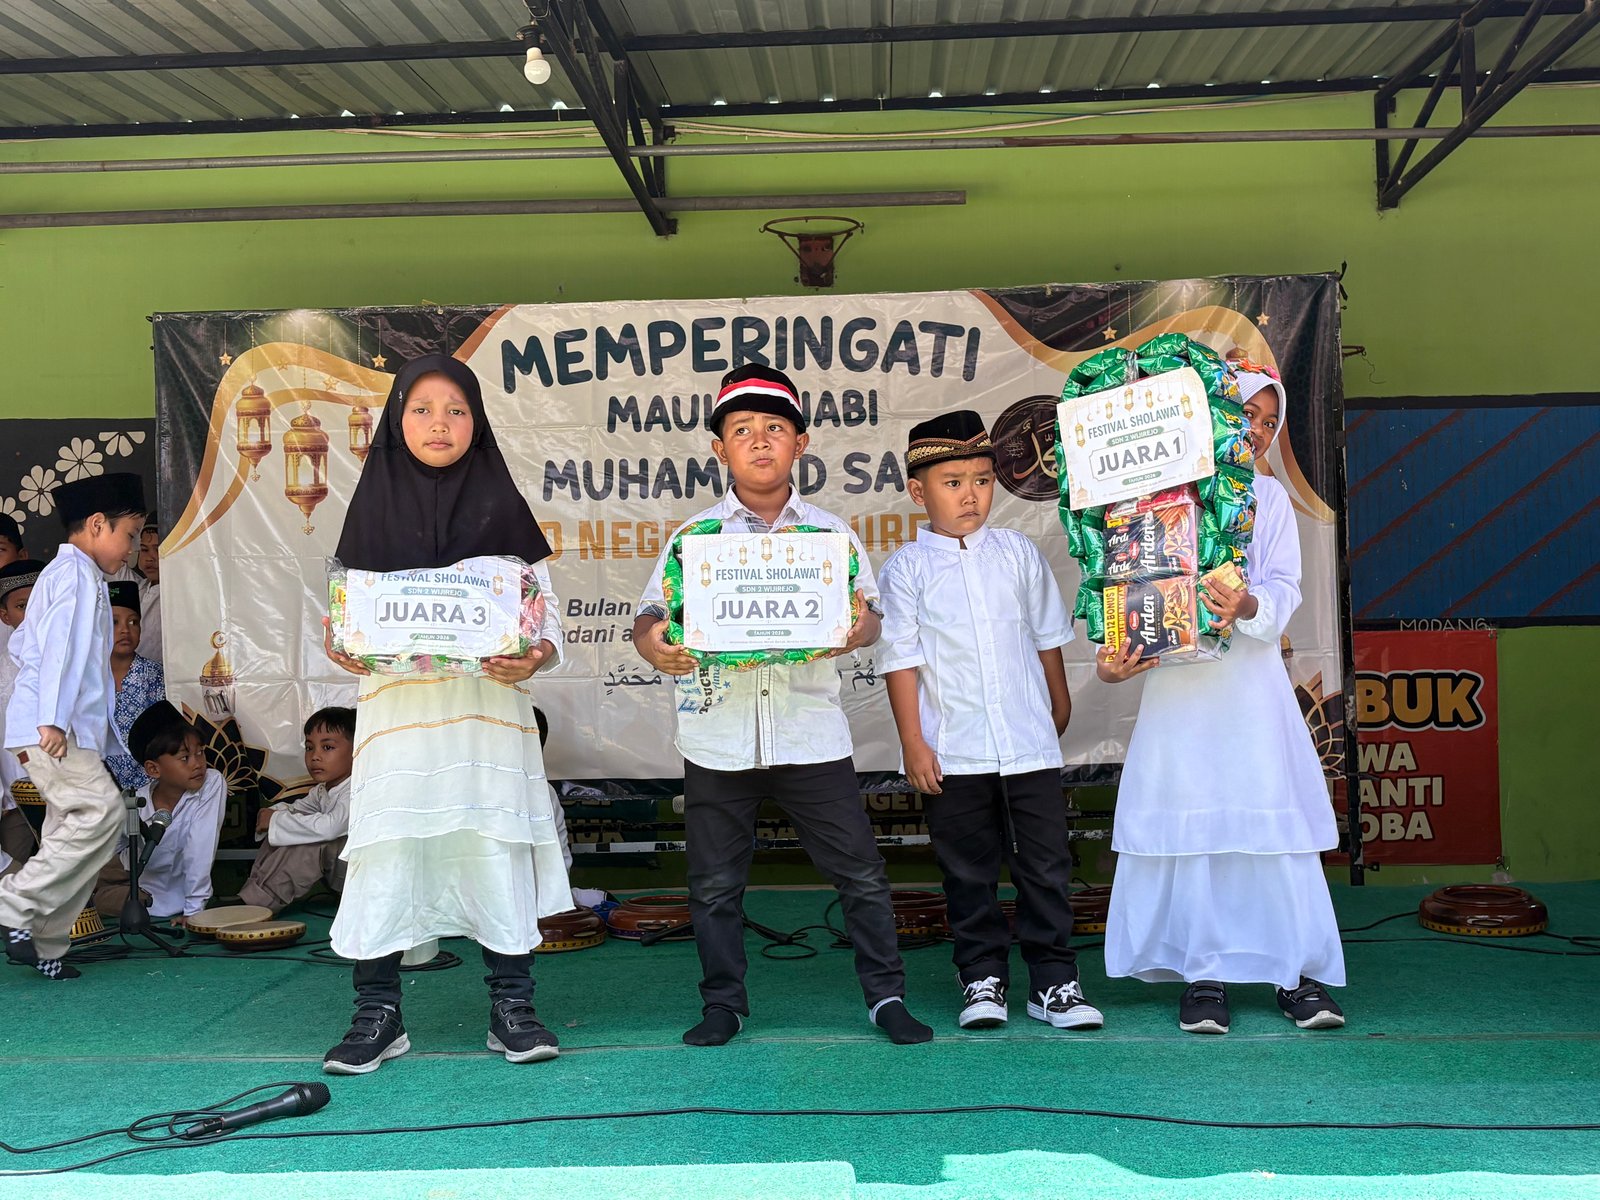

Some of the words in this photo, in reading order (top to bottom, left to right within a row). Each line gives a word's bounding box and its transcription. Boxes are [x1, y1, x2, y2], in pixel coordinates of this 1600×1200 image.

[501, 316, 981, 394] MEMPERINGATI
[1088, 419, 1128, 439] FESTIVAL
[1129, 405, 1180, 427] SHOLAWAT
[1097, 441, 1170, 475] JUARA
[1173, 436, 1181, 454] 1
[542, 454, 827, 502] MUHAMD
[843, 451, 909, 494] SA
[1140, 525, 1158, 573] Arden
[434, 573, 491, 589] SHOLAWAT
[716, 568, 763, 580] FESTIVAL
[766, 568, 821, 580] SHOLAWAT
[379, 602, 466, 624] JUARA
[472, 606, 486, 625] 3
[566, 598, 632, 617] Bulan
[716, 600, 800, 619] JUARA
[804, 599, 819, 618] 2
[1106, 592, 1116, 619] BONUS
[1140, 594, 1158, 645] Arden
[1355, 674, 1483, 728] BUK
